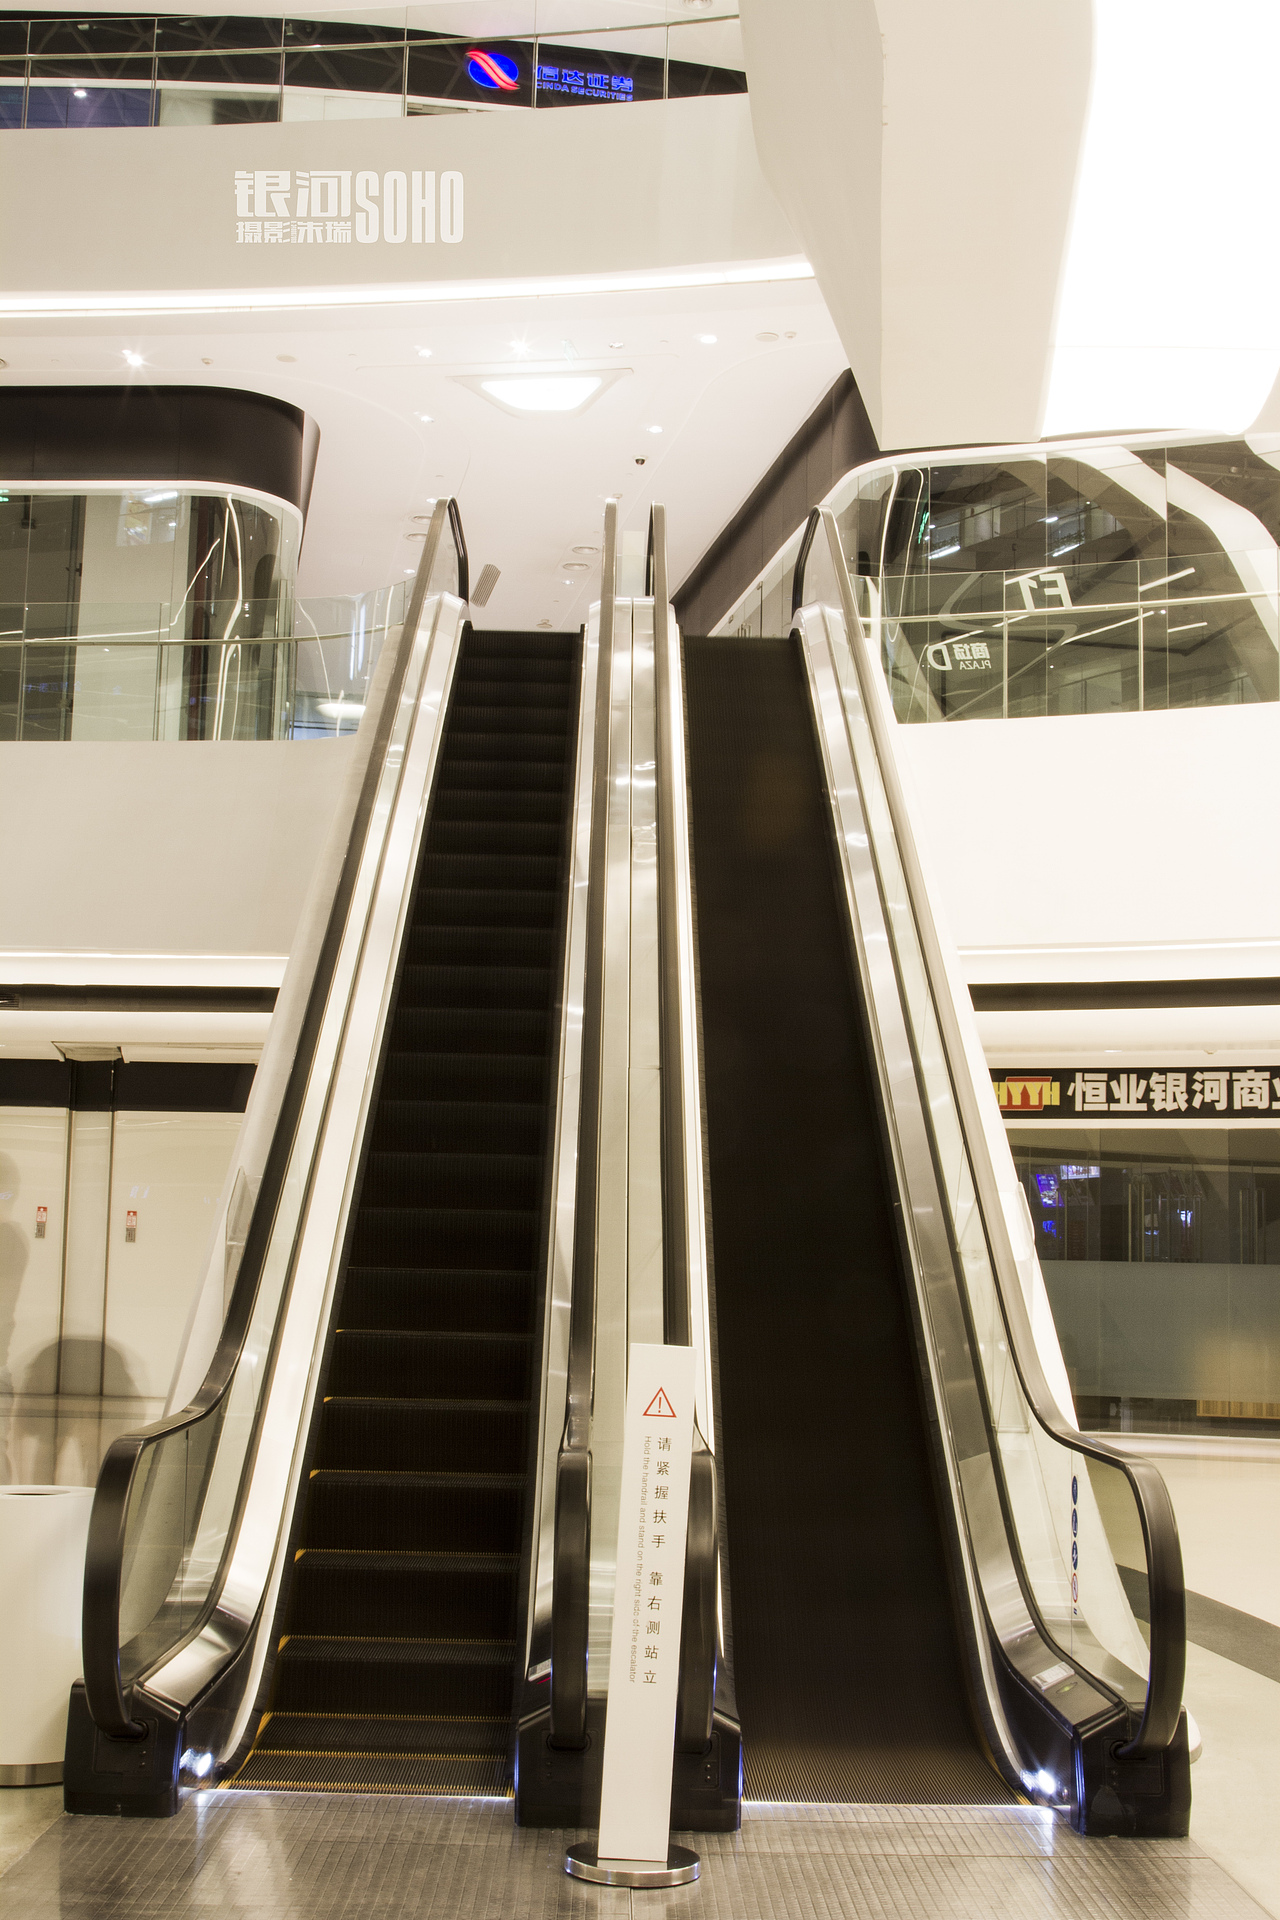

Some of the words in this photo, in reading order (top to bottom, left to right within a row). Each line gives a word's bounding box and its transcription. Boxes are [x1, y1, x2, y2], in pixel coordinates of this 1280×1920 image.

[536, 81, 570, 93] CINDA
[571, 86, 634, 101] SECURITIES
[644, 1435, 652, 1455] Hold
[642, 1457, 650, 1470] the
[640, 1472, 650, 1506] handrail
[651, 1437, 672, 1548] 请紧握扶手
[637, 1525, 646, 1549] stand
[637, 1550, 644, 1560] on
[635, 1563, 643, 1577] the
[633, 1578, 642, 1597] right
[629, 1644, 638, 1683] escalator
